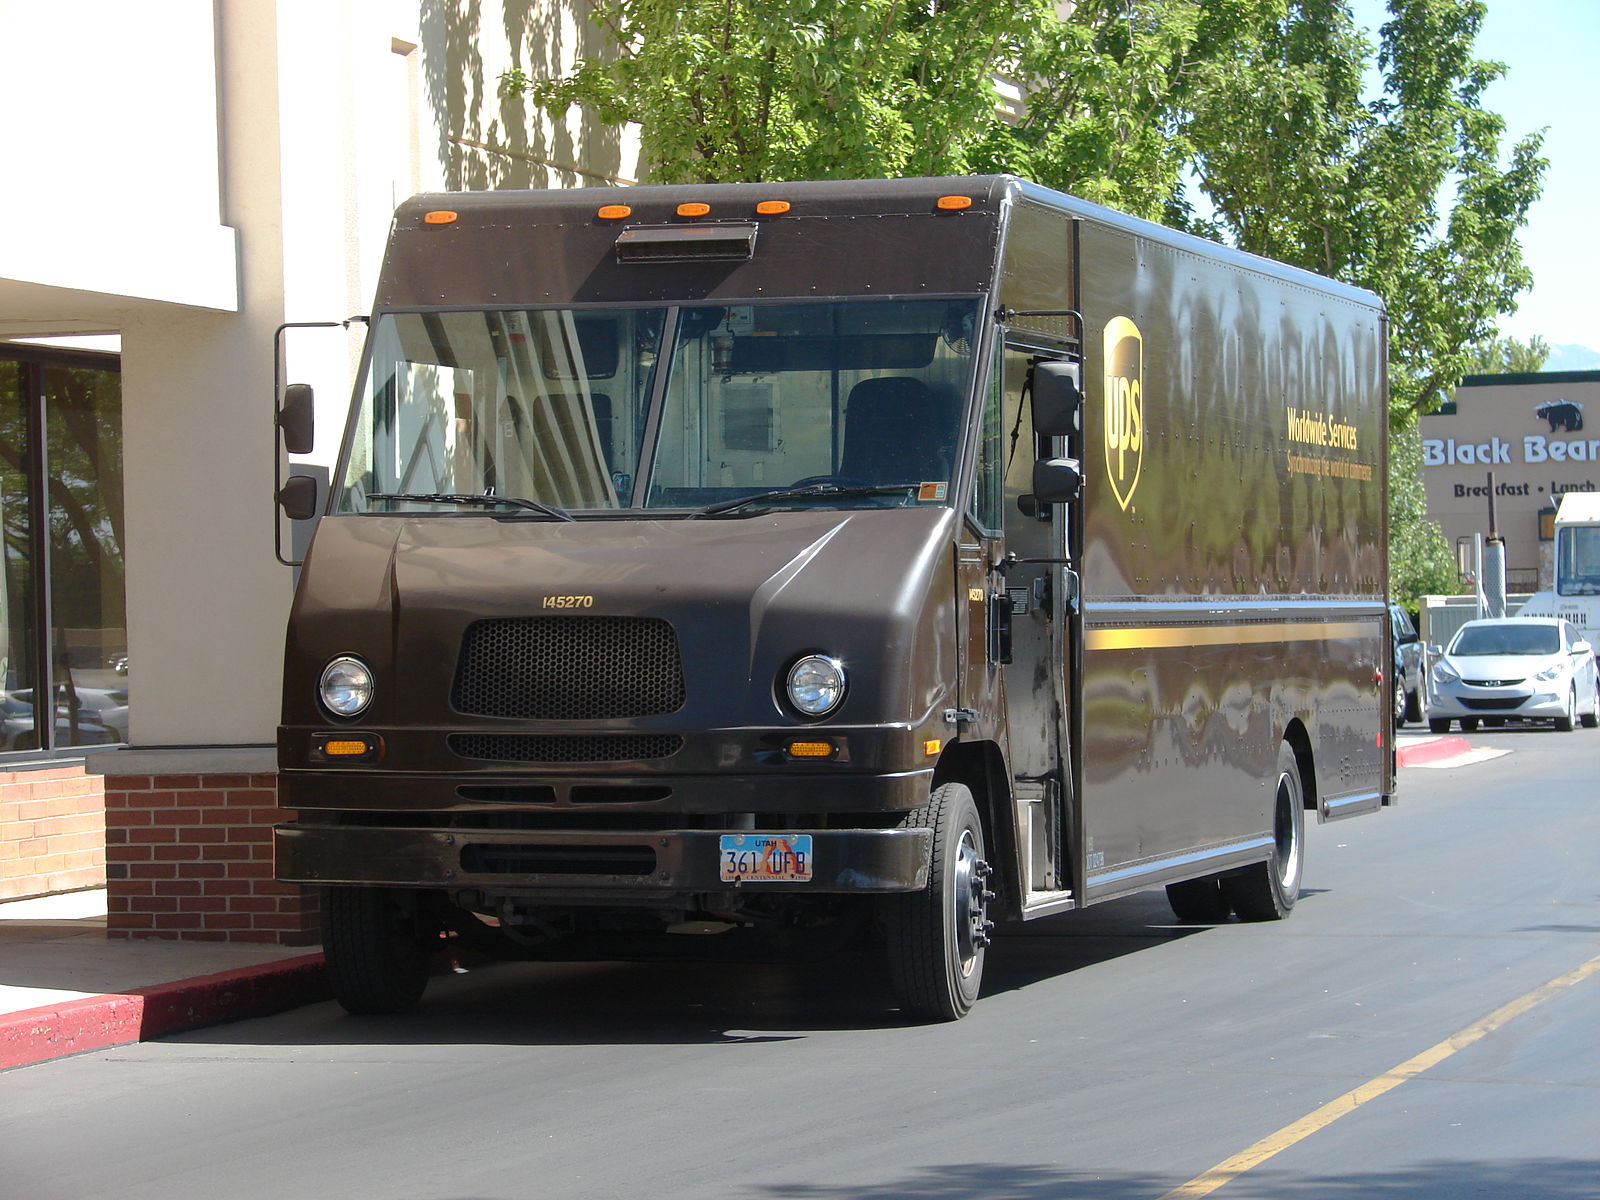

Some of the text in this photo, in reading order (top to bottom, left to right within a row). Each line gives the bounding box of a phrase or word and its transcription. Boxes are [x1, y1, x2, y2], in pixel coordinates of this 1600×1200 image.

[1107, 376, 1140, 480] ups
[1287, 407, 1357, 450] Worldwide Services
[1423, 435, 1600, 466] Black Bear
[542, 595, 593, 609] 145270
[727, 851, 805, 874] 361 UFB
